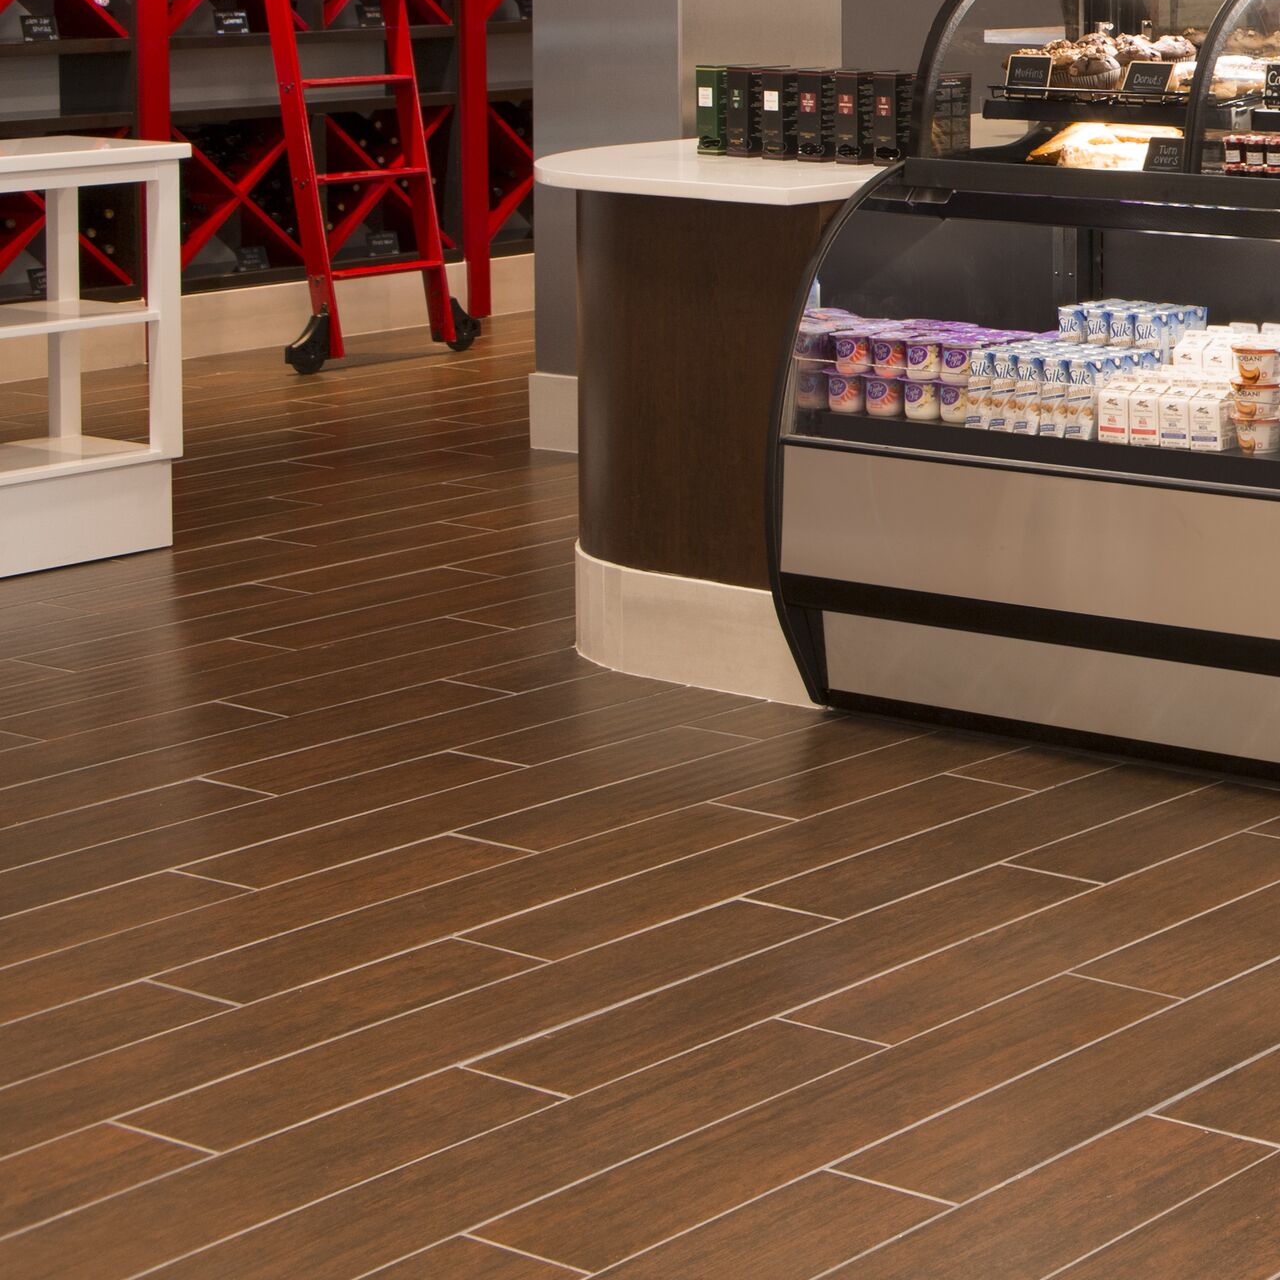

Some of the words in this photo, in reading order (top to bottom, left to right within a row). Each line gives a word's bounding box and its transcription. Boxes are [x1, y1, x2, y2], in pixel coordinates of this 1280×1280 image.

[1014, 68, 1044, 80] Muffins
[1133, 73, 1164, 85] Donuts
[1159, 144, 1178, 155] Turn
[1154, 155, 1179, 166] overs
[1059, 317, 1078, 333] Silk
[1087, 319, 1106, 335] Silk
[1110, 322, 1131, 338] Silk
[1135, 324, 1156, 341] Silk
[970, 360, 992, 376] Silk
[993, 361, 1016, 378] Silk
[1017, 364, 1038, 380] Silk
[1044, 367, 1066, 383] Silk
[1069, 368, 1092, 385] Silk
